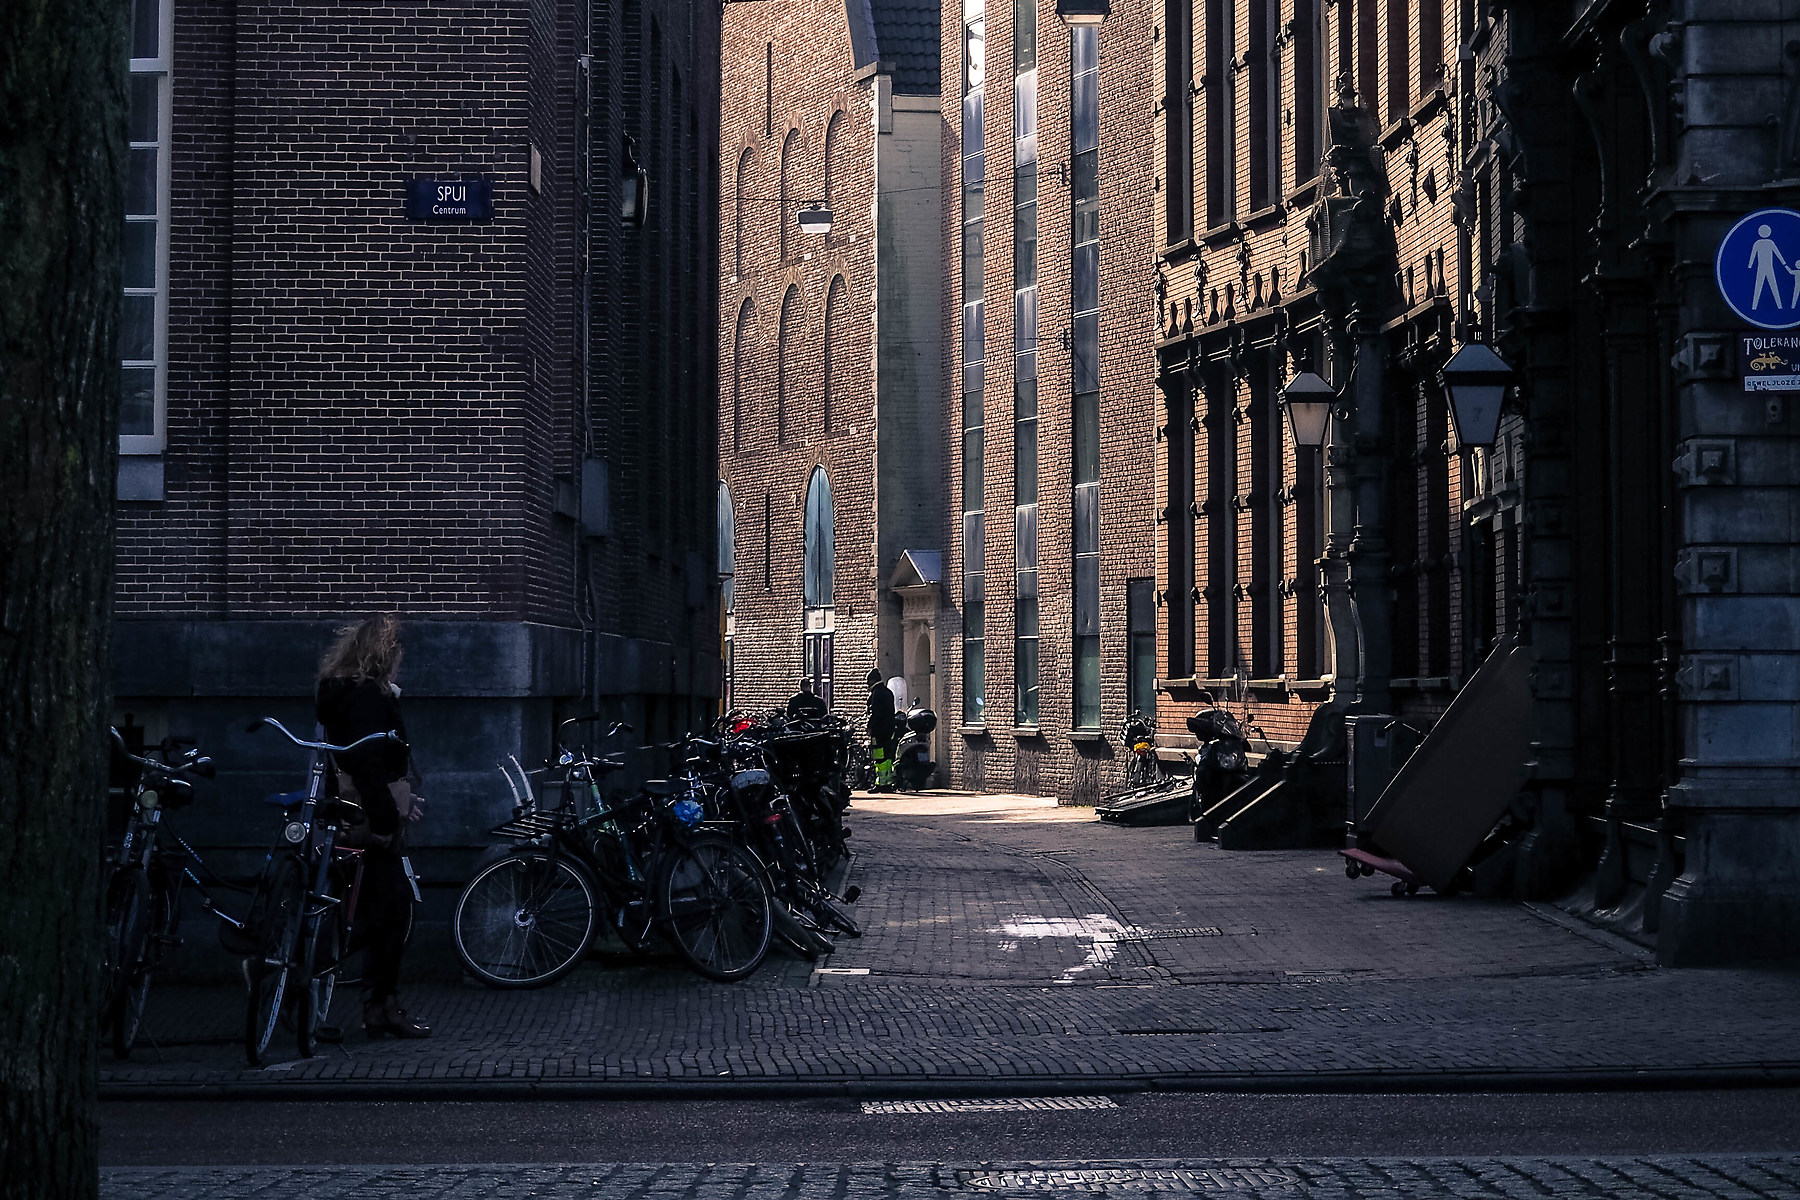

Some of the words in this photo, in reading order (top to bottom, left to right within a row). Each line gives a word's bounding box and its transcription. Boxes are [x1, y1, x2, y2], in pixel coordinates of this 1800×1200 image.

[437, 185, 466, 202] SPUI
[432, 204, 467, 215] Centrum
[1743, 337, 1800, 356] TOLERAN
